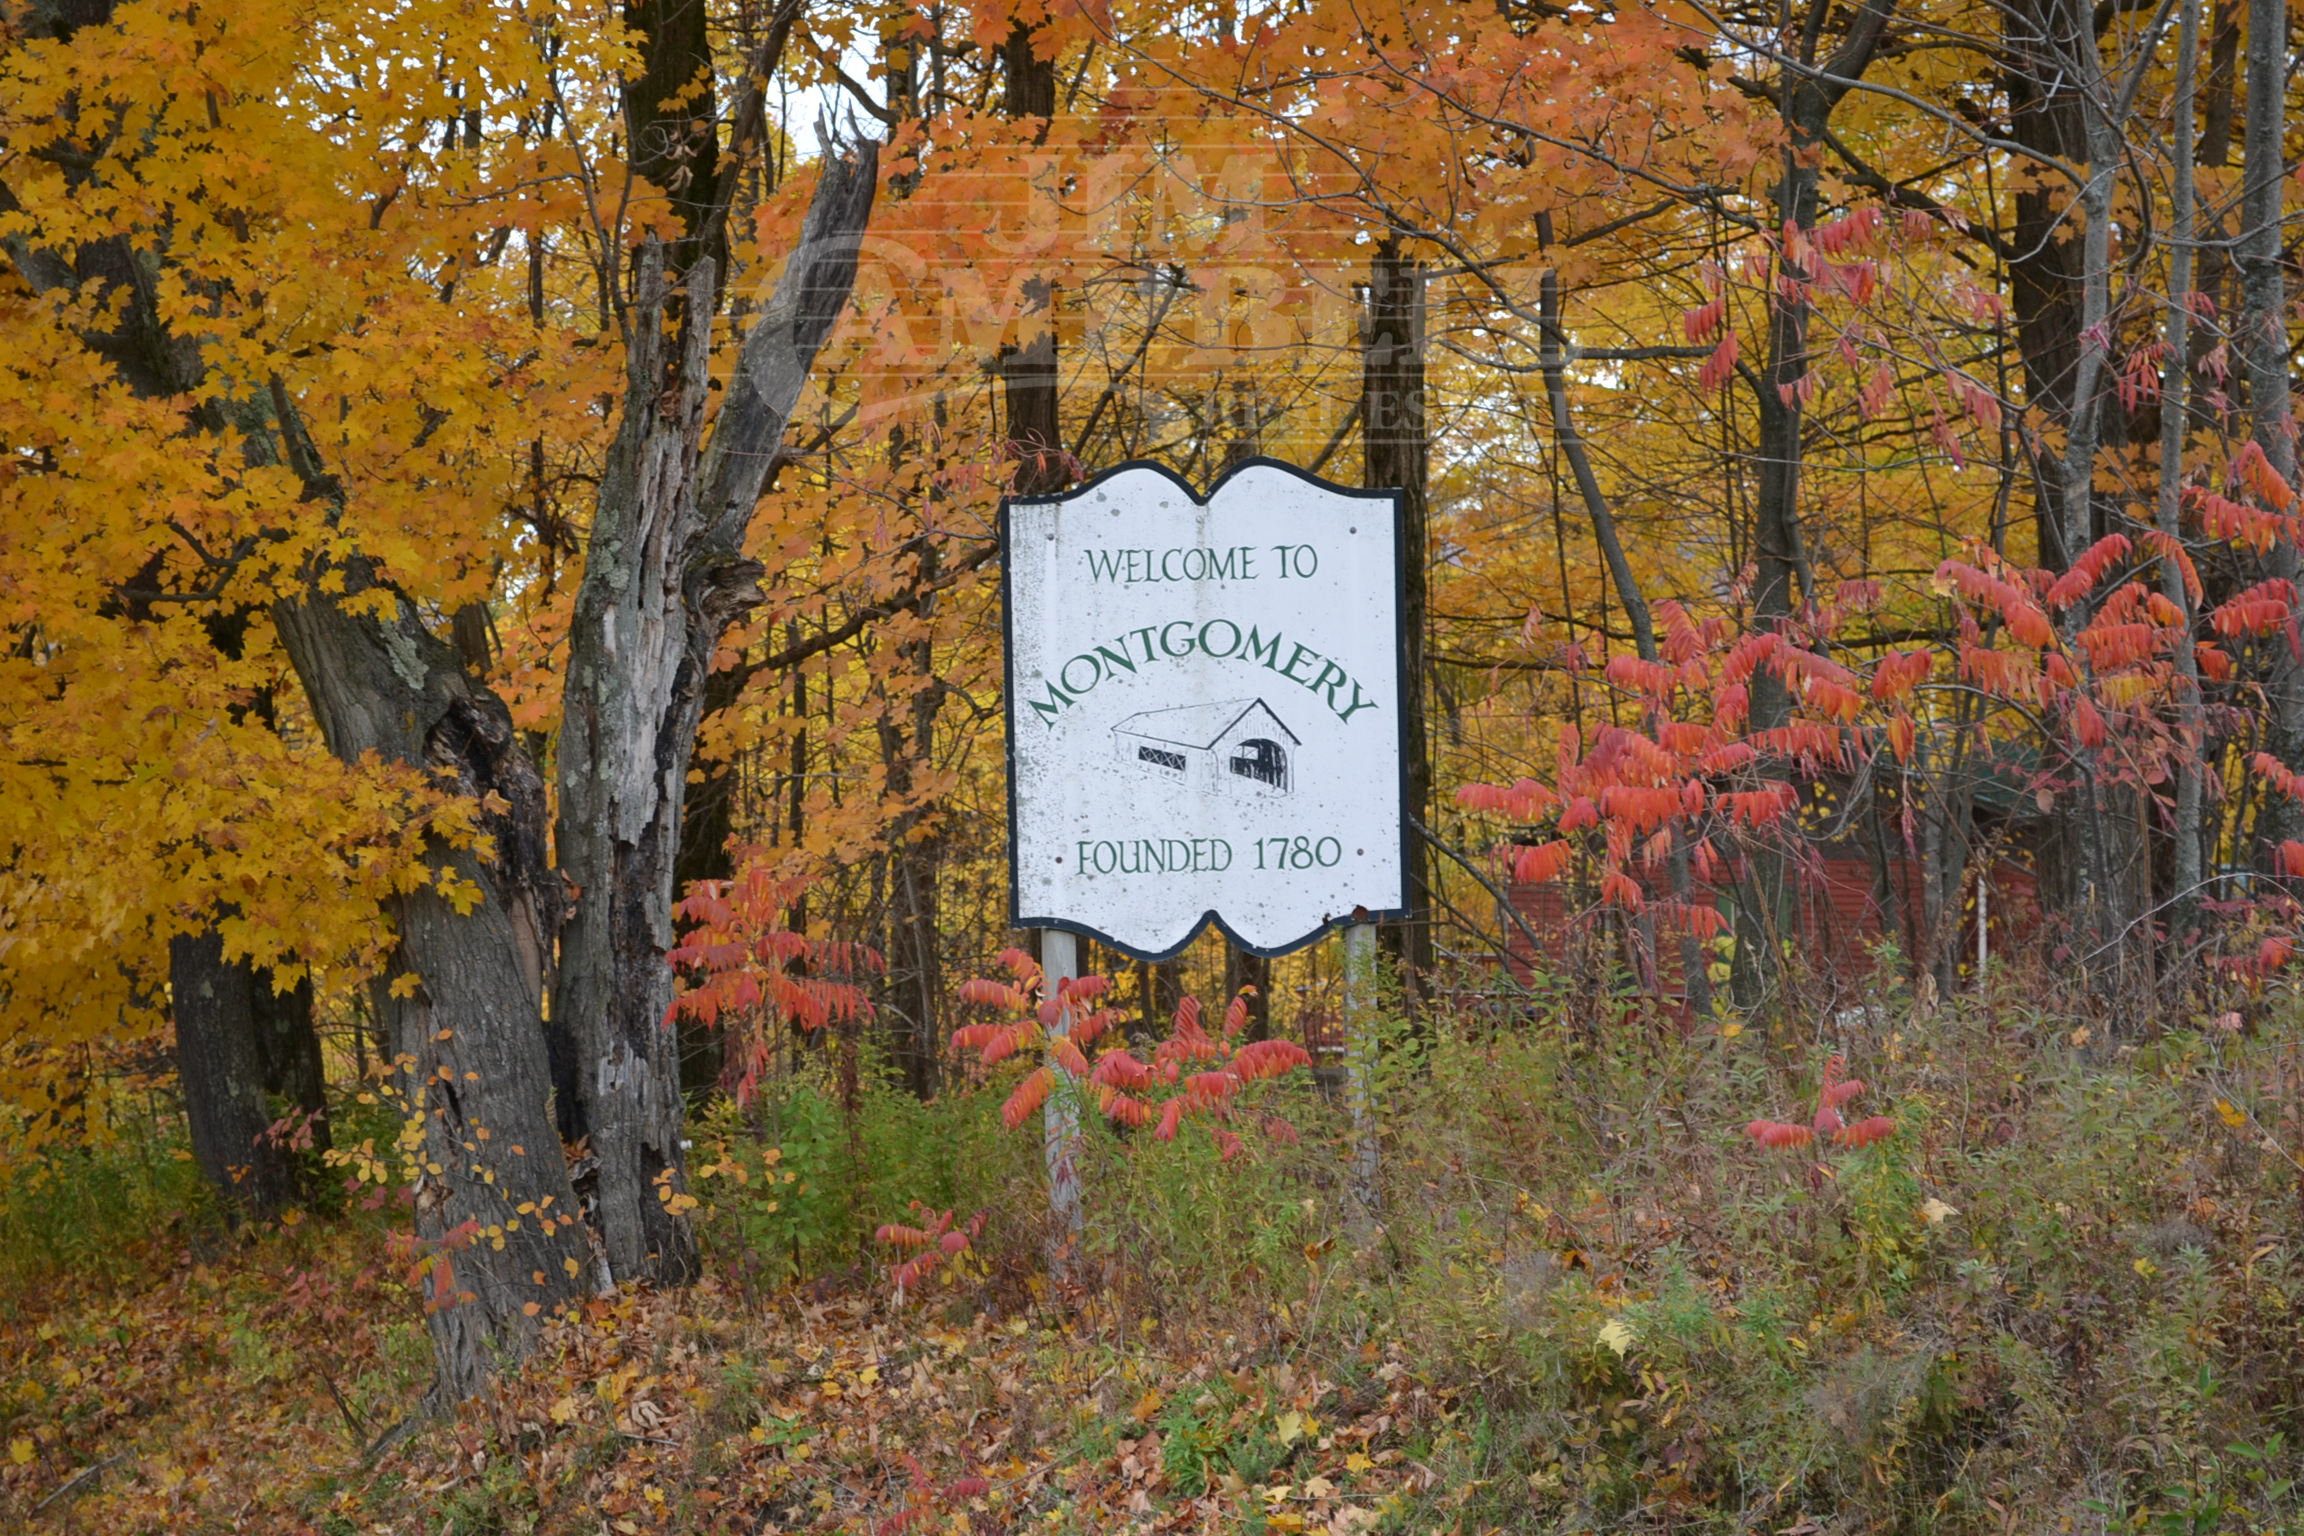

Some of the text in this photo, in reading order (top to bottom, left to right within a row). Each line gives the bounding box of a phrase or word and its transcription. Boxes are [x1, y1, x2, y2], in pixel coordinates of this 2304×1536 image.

[1083, 543, 1318, 584] WELCOME TO
[1027, 618, 1379, 732] MONTGOMERY
[1075, 835, 1342, 876] FOUNDED 1780
